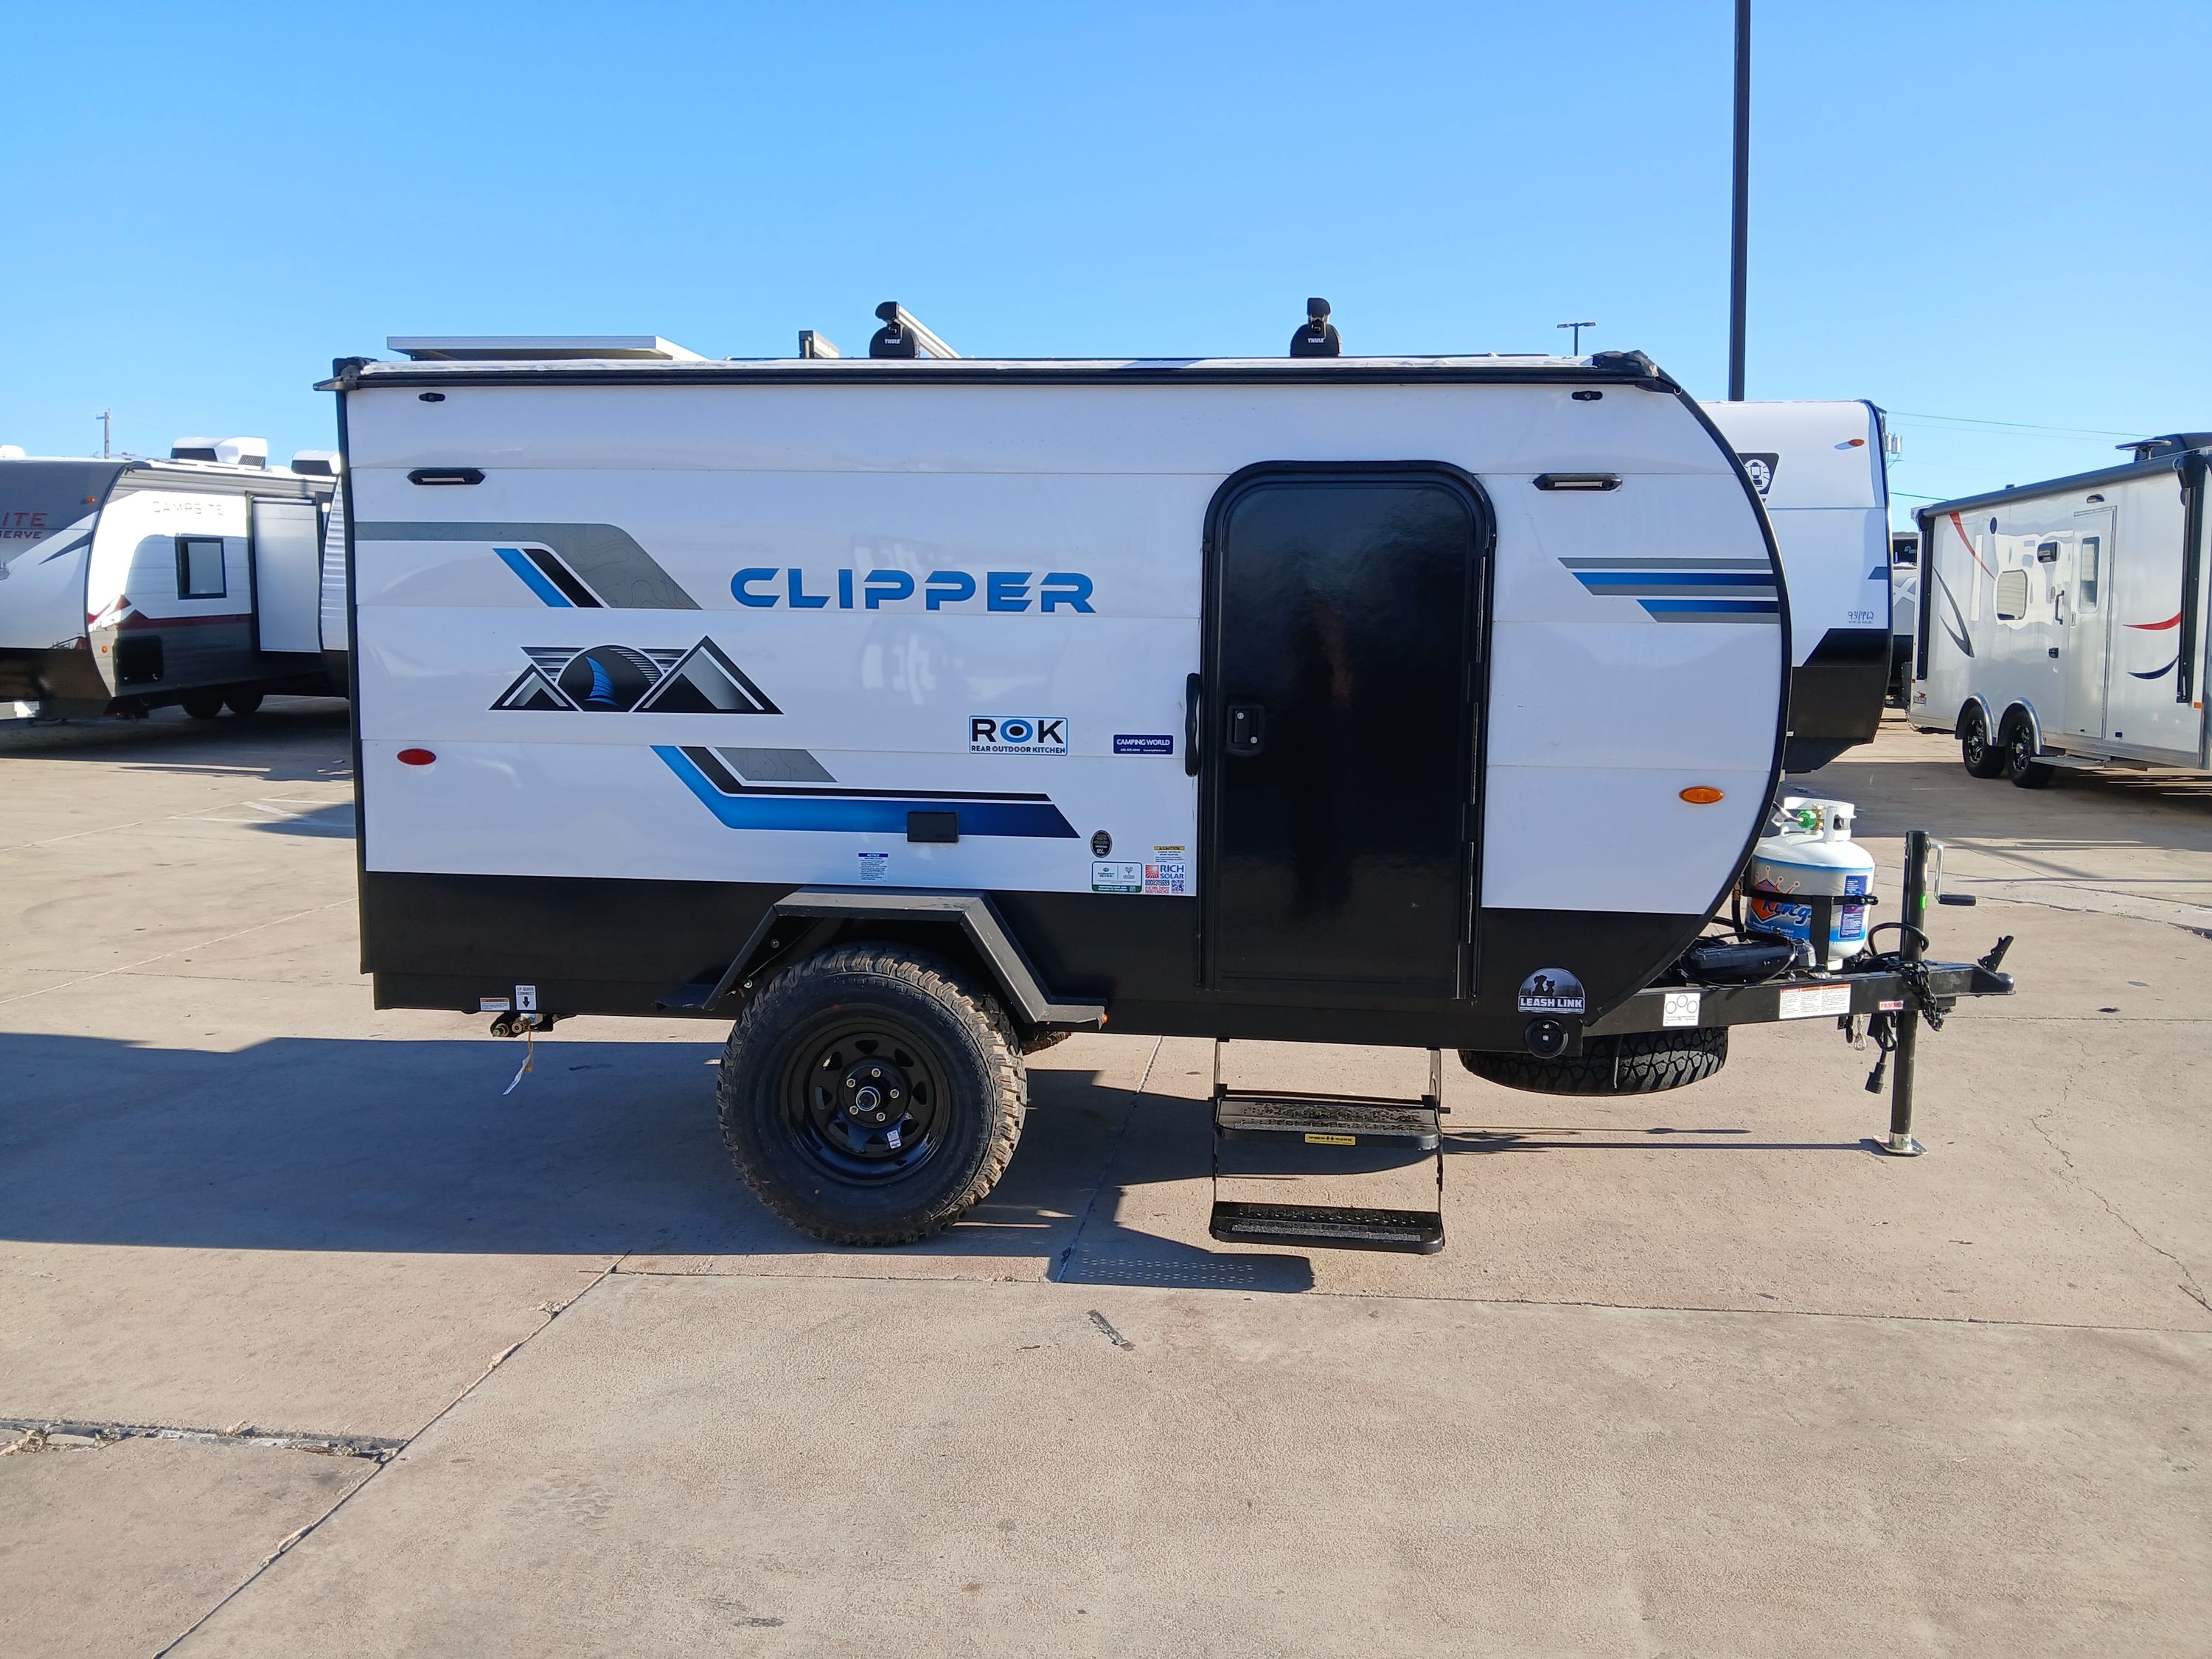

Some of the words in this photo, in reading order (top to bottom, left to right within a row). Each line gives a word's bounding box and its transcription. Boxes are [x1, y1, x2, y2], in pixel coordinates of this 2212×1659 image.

[153, 501, 223, 516] CAMPSTE
[0, 530, 42, 539] ERVE
[730, 567, 1097, 613] CLIPPER
[971, 718, 1064, 744] ROK
[1160, 864, 1184, 873] RICH
[1520, 998, 1555, 1007] LEASH
[1557, 998, 1582, 1008] LINK
